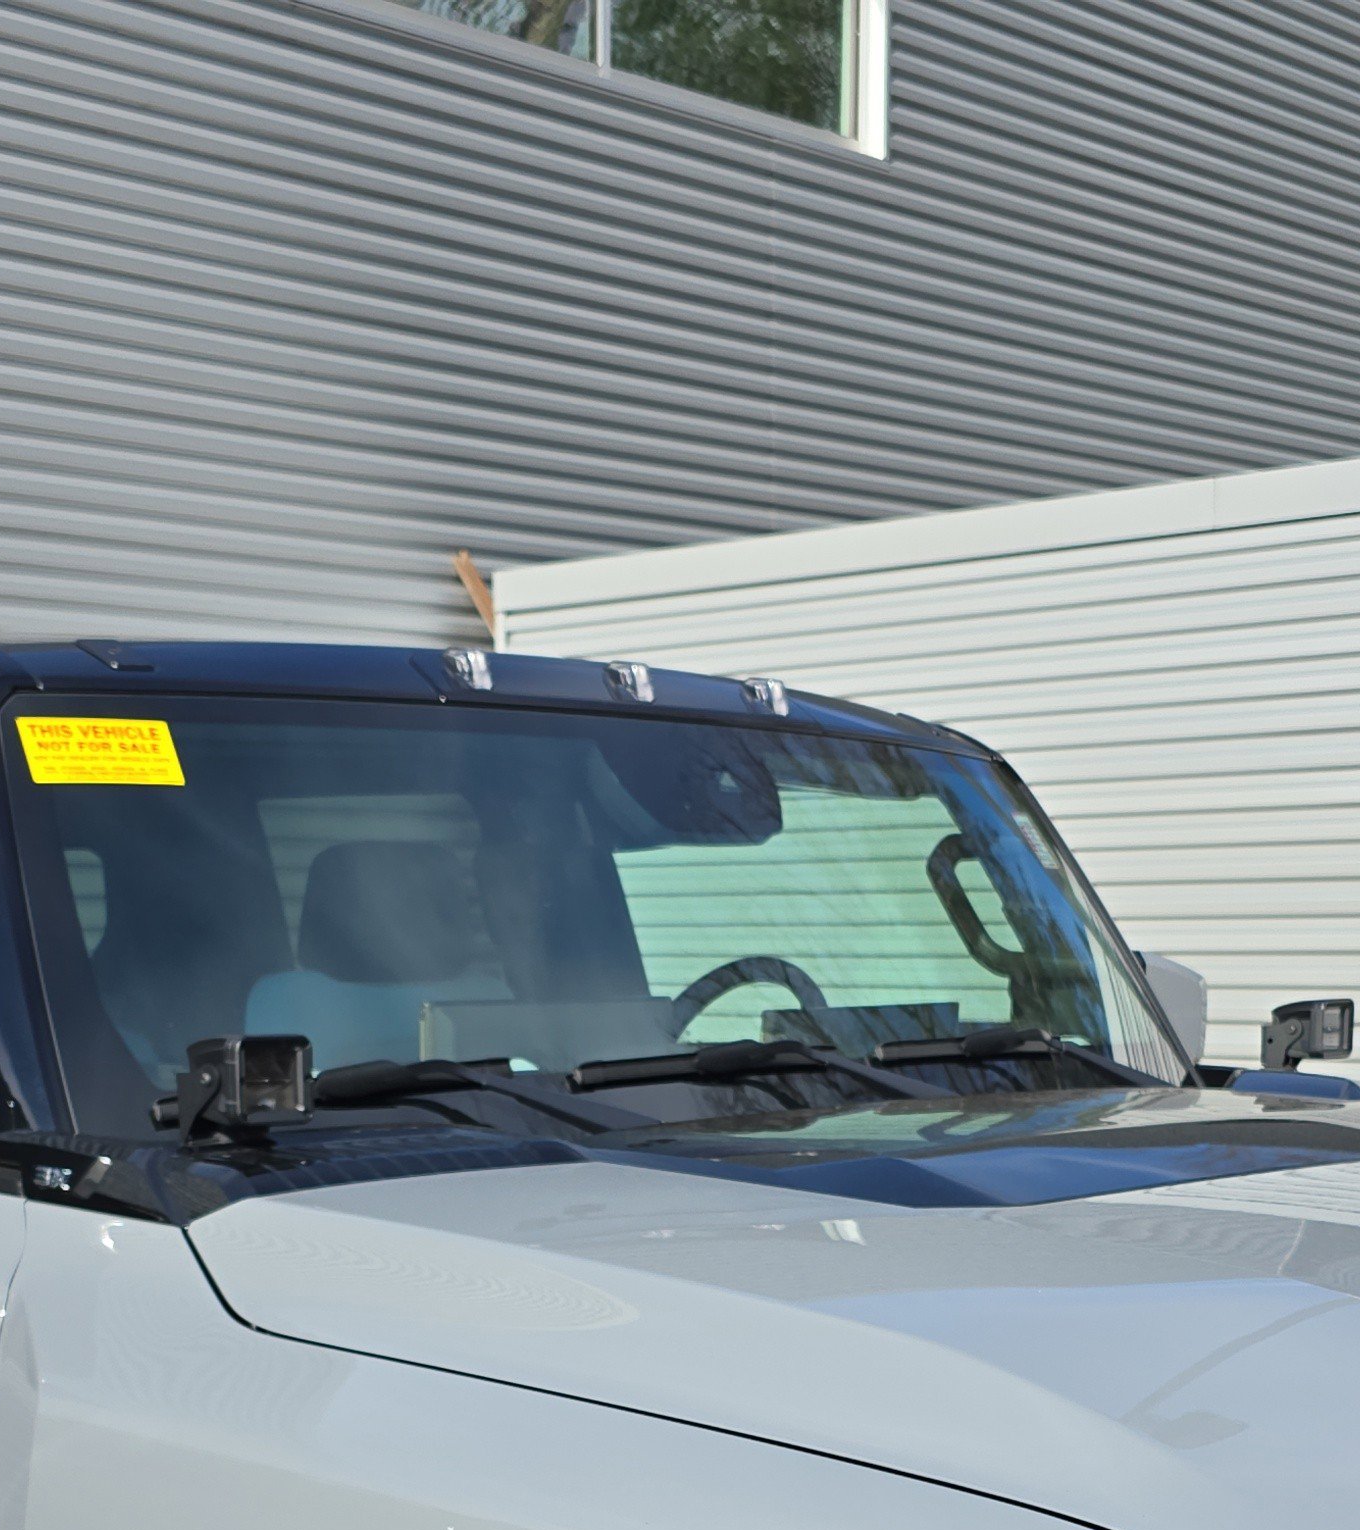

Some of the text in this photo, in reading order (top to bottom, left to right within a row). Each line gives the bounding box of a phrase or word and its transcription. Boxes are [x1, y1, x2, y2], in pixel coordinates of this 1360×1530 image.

[28, 724, 160, 740] THIS VEHICLE
[37, 742, 160, 753] NOT FOR SALE
